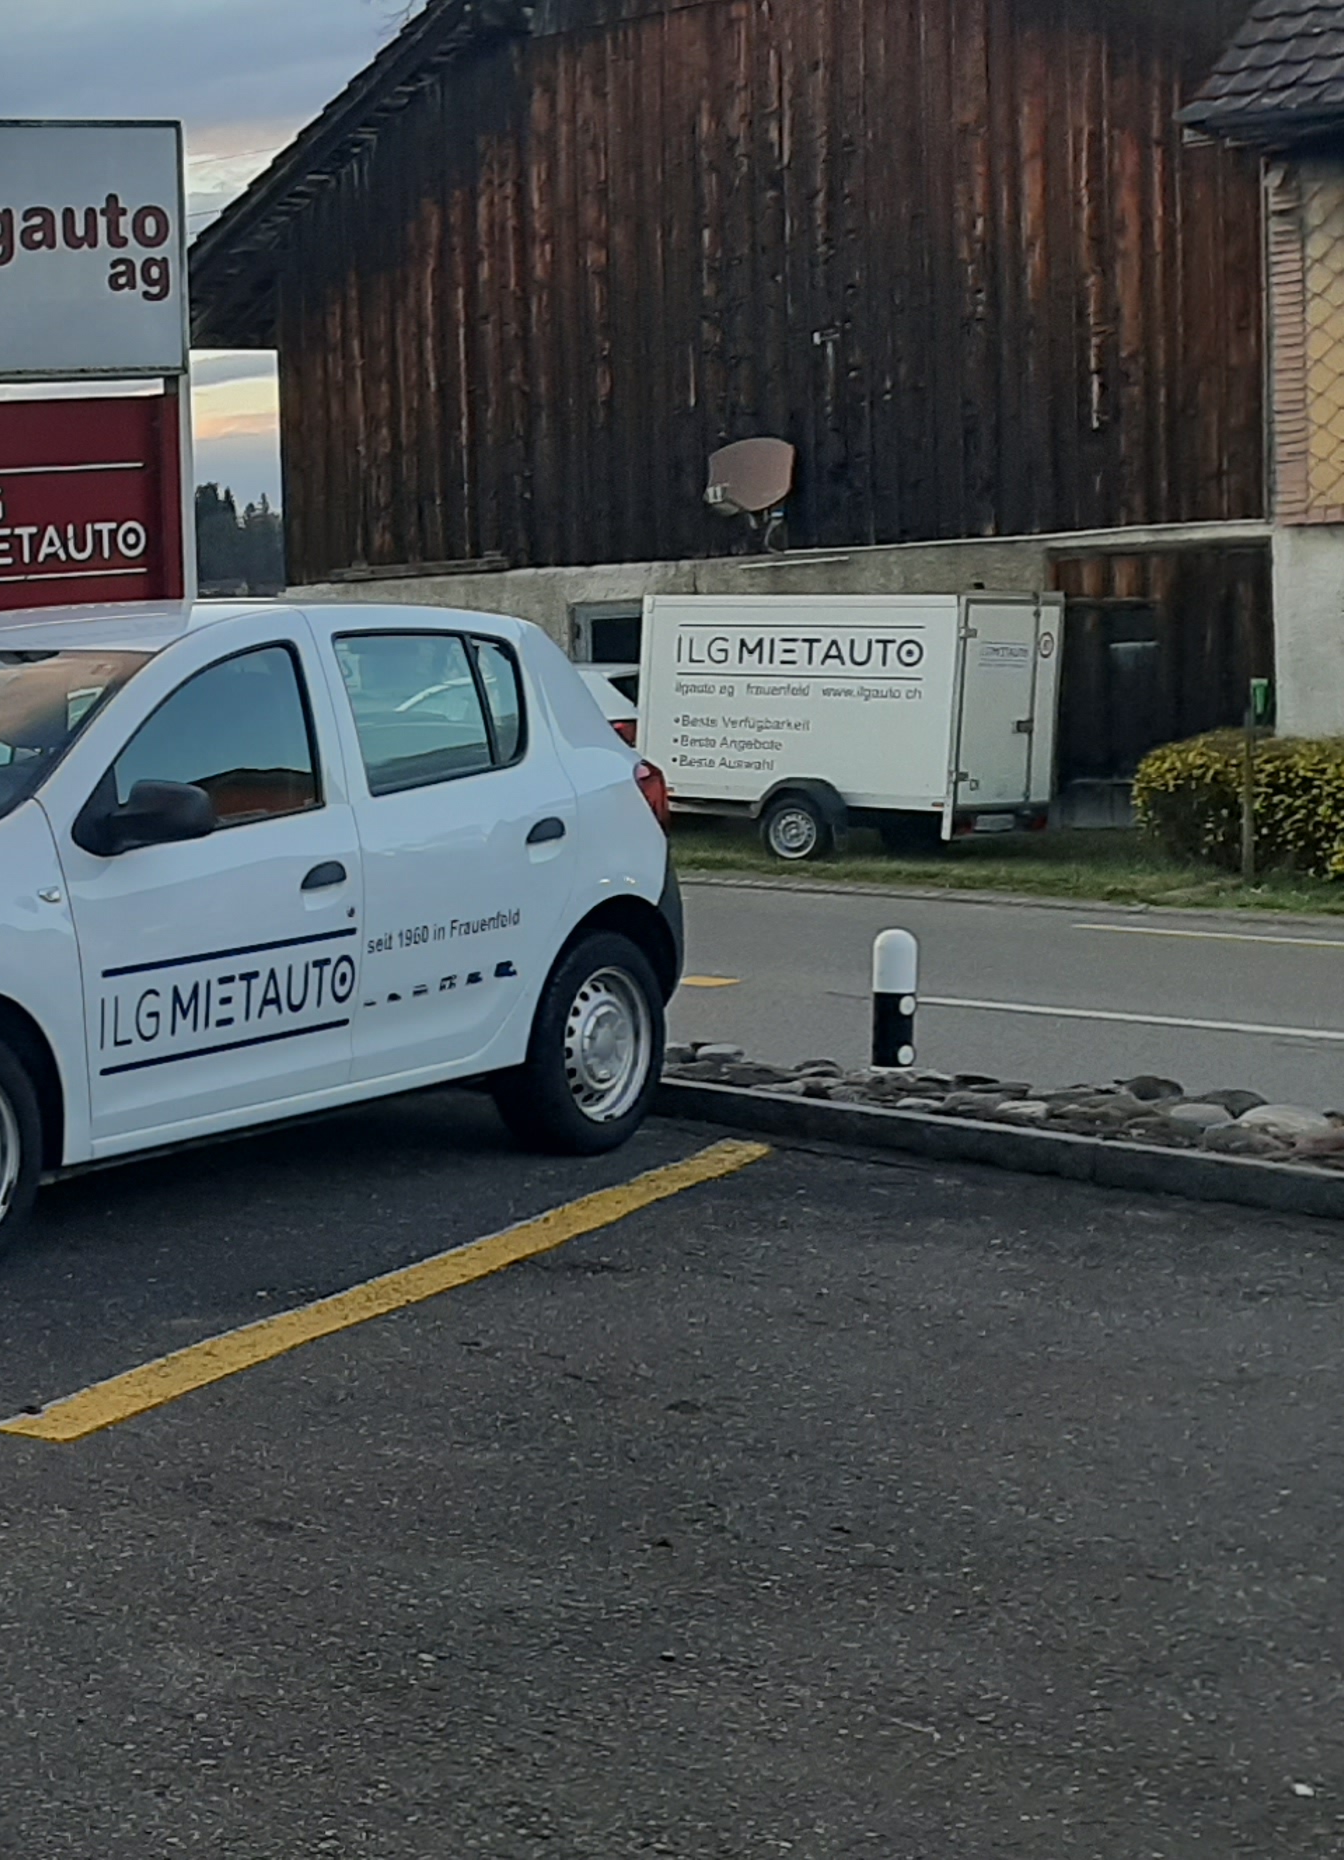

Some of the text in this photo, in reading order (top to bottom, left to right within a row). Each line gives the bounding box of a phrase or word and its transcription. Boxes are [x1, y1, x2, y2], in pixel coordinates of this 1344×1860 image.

[107, 256, 170, 300] ag
[676, 634, 924, 667] ILG MIETAUTO
[821, 684, 923, 702] www.ilgautoch
[367, 908, 521, 954] seit 1960 in Frauenfeld
[99, 953, 357, 1050] ILG MIETAUTO
